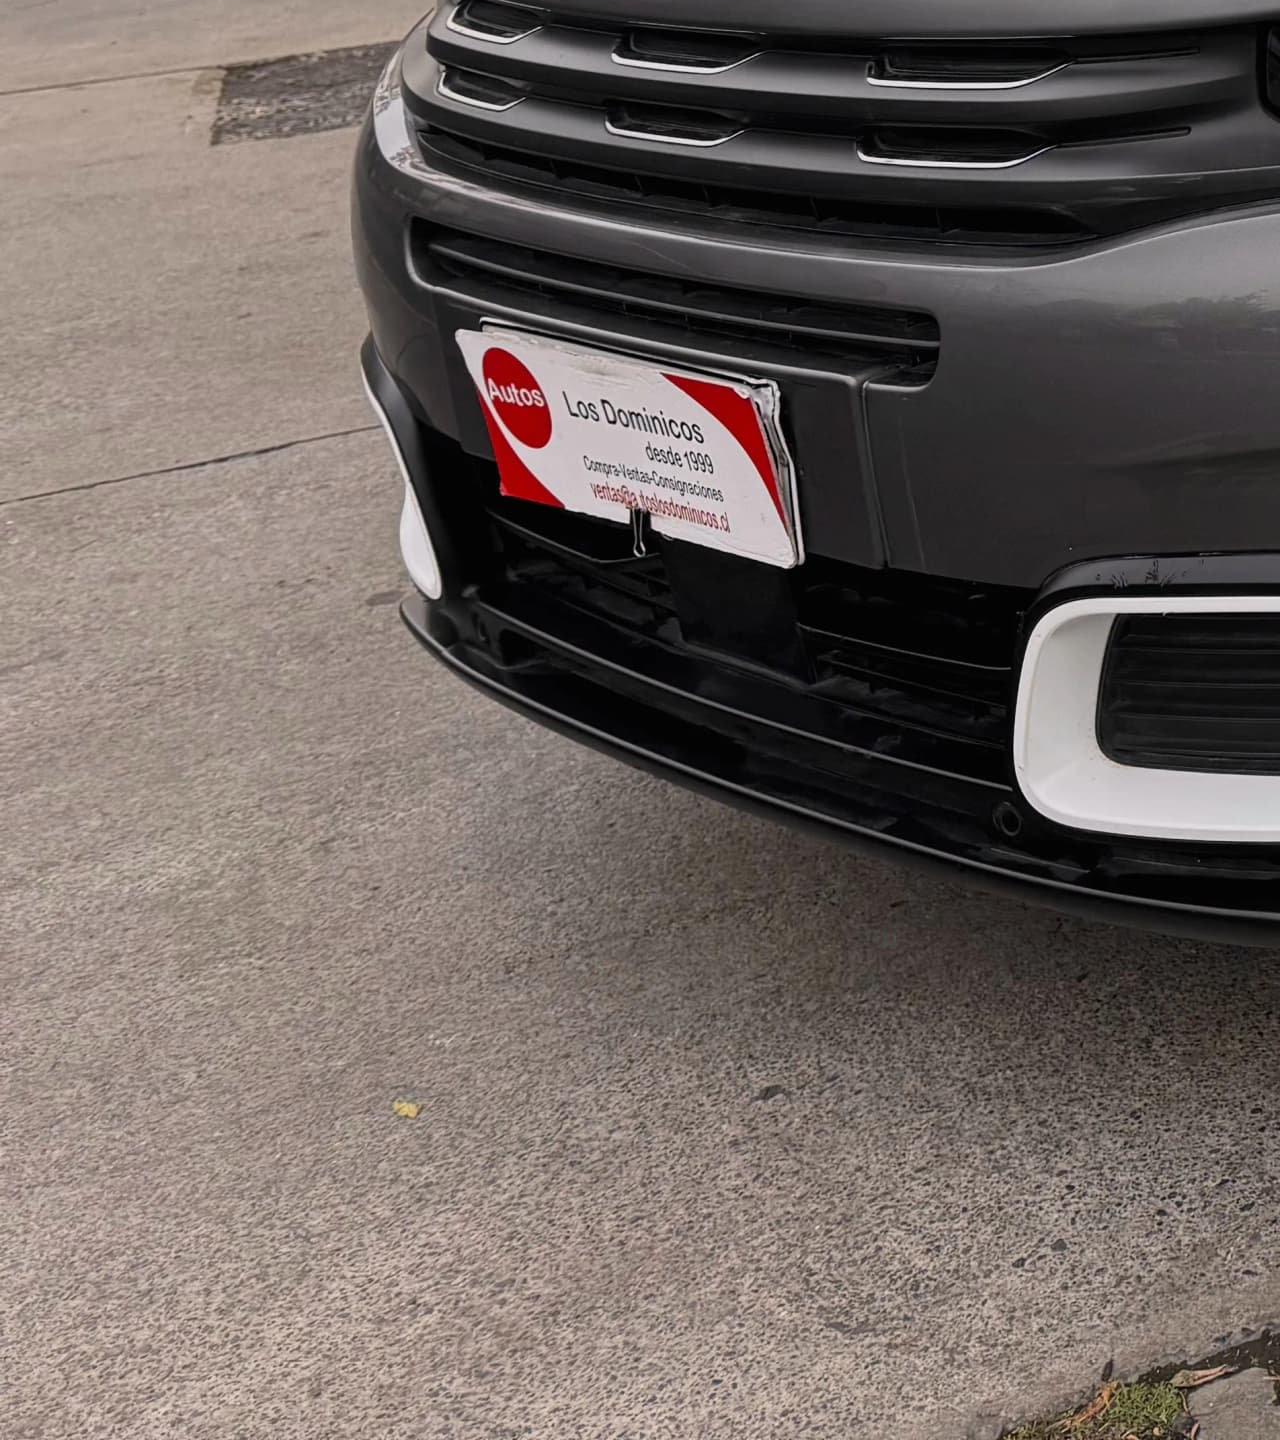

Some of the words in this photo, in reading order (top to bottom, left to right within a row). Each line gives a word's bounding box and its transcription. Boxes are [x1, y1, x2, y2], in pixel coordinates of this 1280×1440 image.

[487, 377, 546, 408] Autos
[561, 390, 600, 422] Los
[600, 398, 705, 444] Dominicos
[645, 441, 684, 468] desde
[683, 450, 715, 474] 1999
[590, 481, 731, 533] ventas@atoslosdominicos.cl
